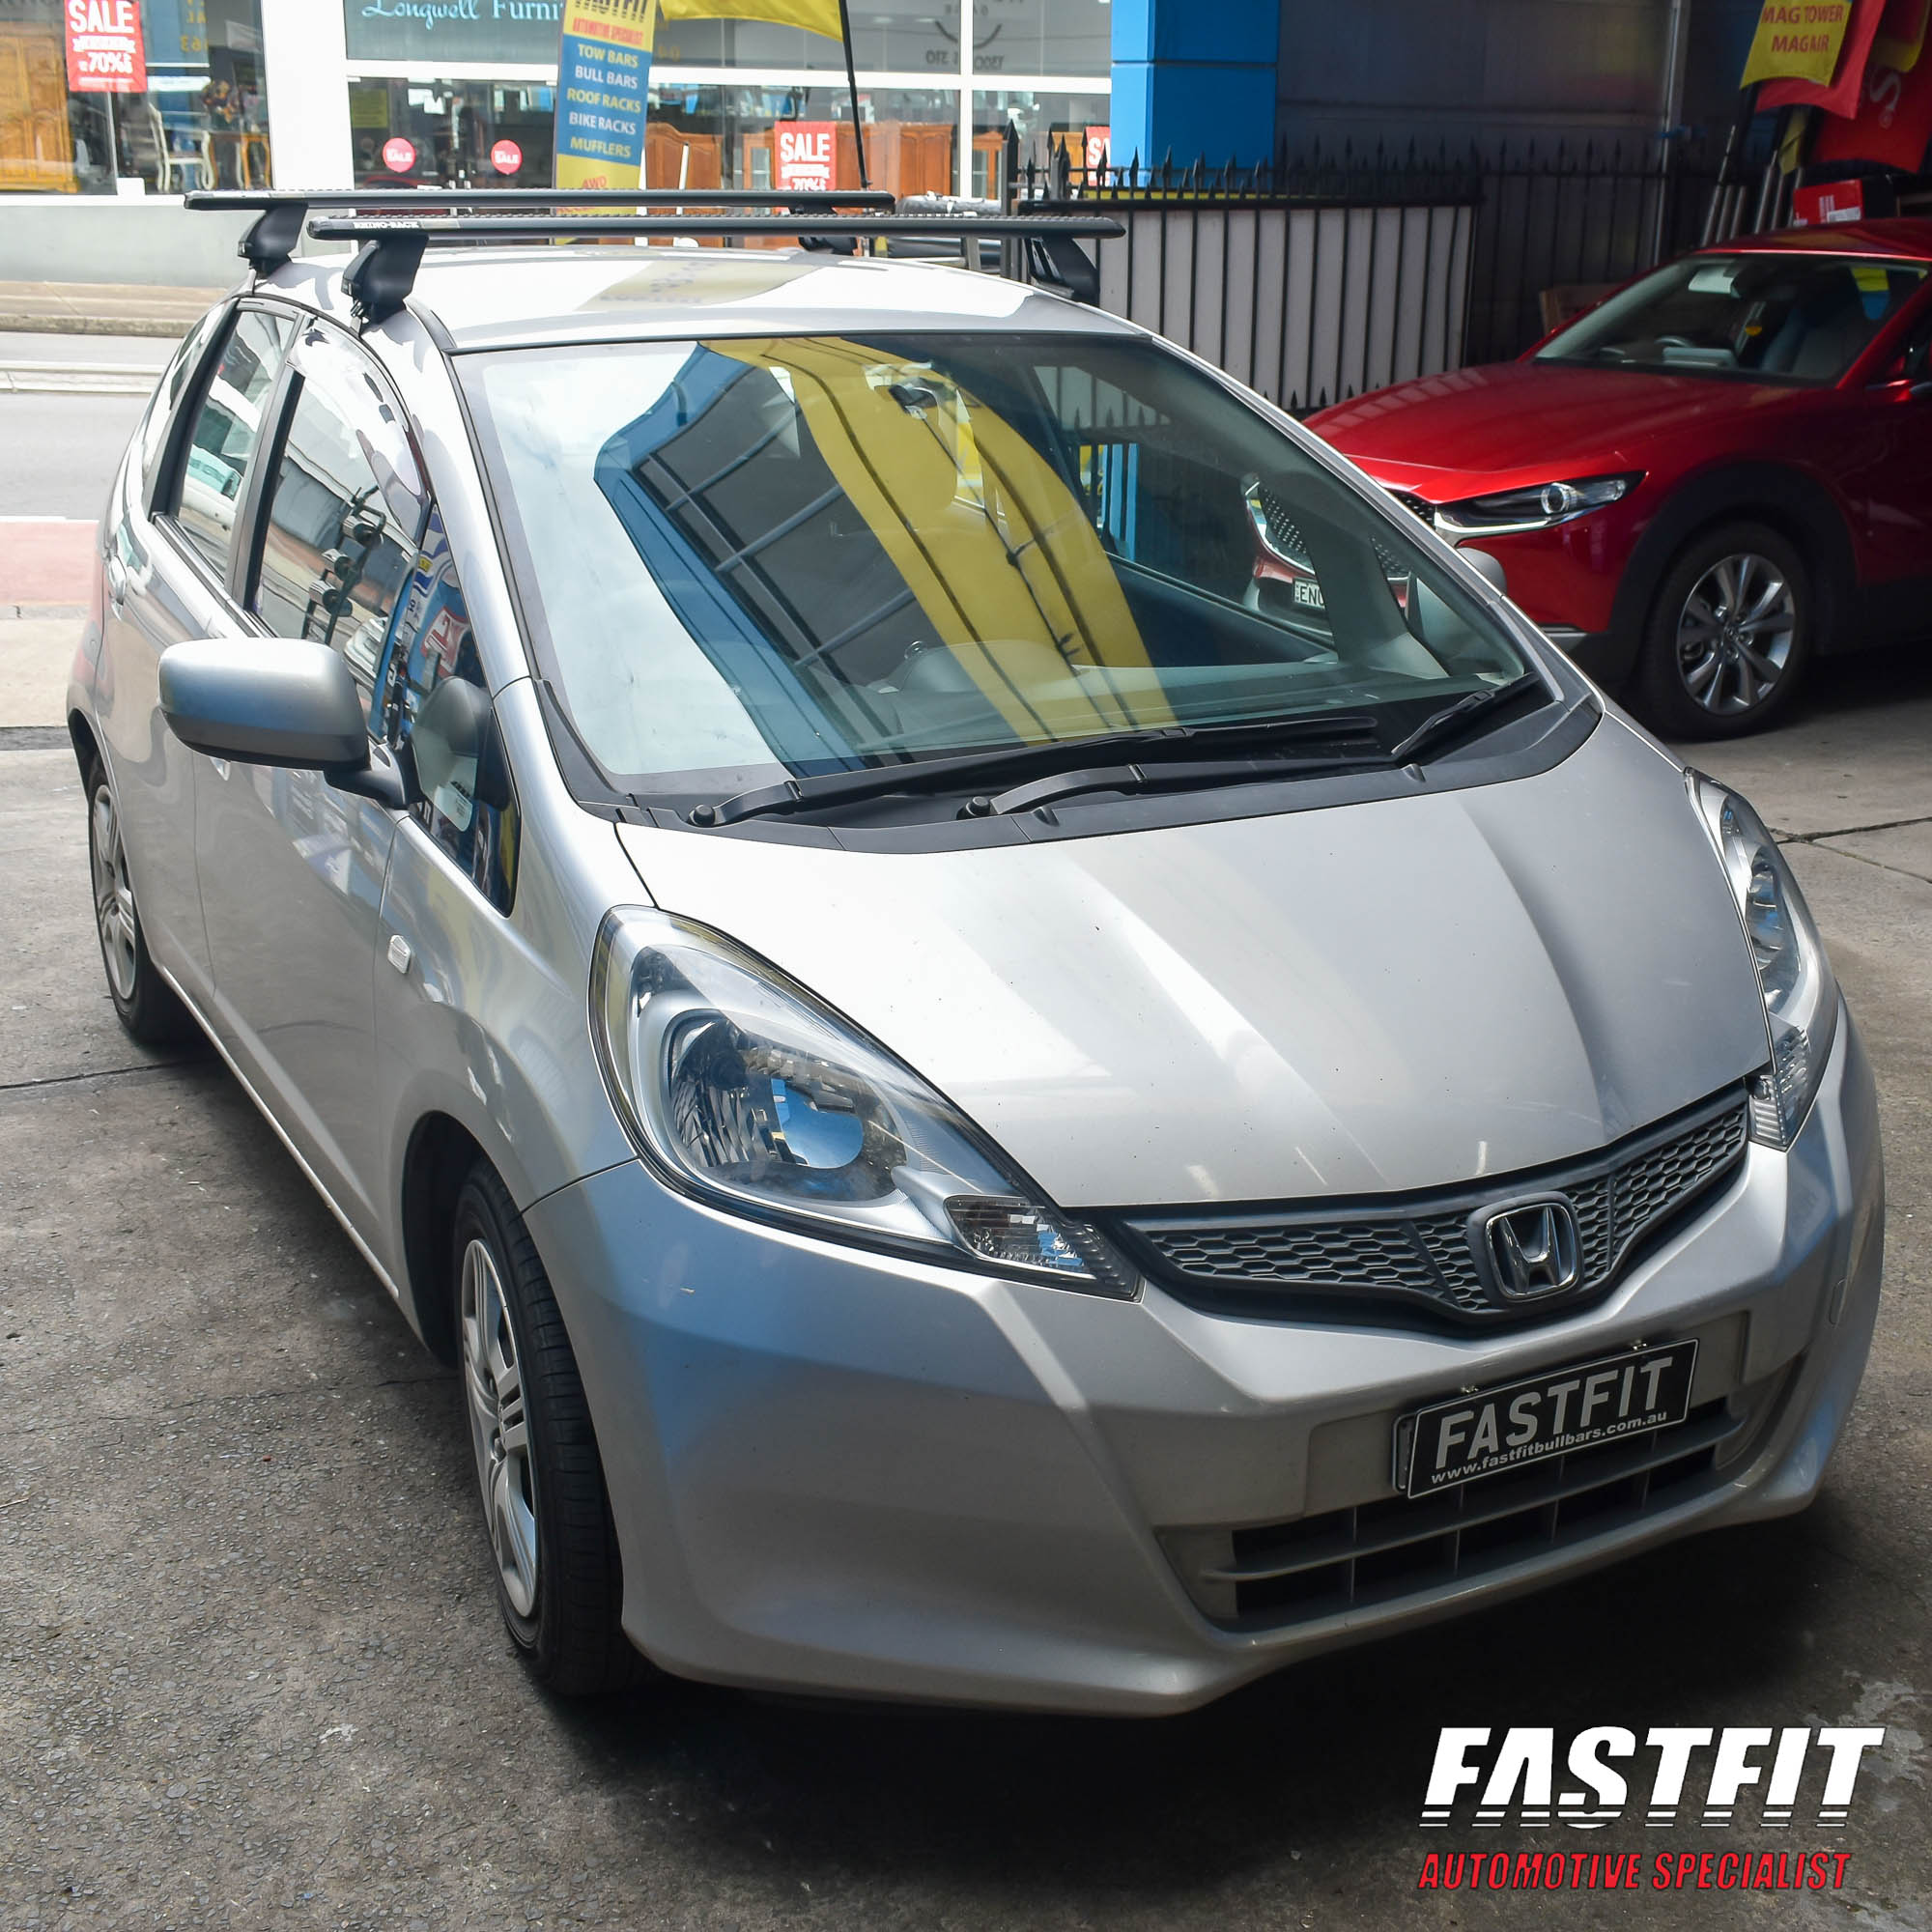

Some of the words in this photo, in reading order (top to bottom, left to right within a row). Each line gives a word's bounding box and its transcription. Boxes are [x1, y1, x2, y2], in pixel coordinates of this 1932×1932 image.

[68, 0, 135, 34] SALE
[361, 0, 480, 30] Longwell
[493, 0, 564, 20] Furni
[1761, 5, 1801, 24] MAG
[1804, 5, 1844, 23] TOWER
[578, 43, 606, 61] TOW
[607, 49, 639, 69] BARS
[575, 65, 604, 83] BULL
[606, 71, 639, 90] BARS
[566, 87, 601, 105] ROOF
[602, 94, 642, 114] RACKS
[568, 111, 597, 129] BIKE
[598, 115, 637, 135] RACKS
[570, 136, 632, 158] MUFFLERS
[780, 131, 831, 162] SALE
[1435, 1356, 1673, 1469] FASTFIT
[1431, 1410, 1668, 1485] www.fastfitbullbars.com.au
